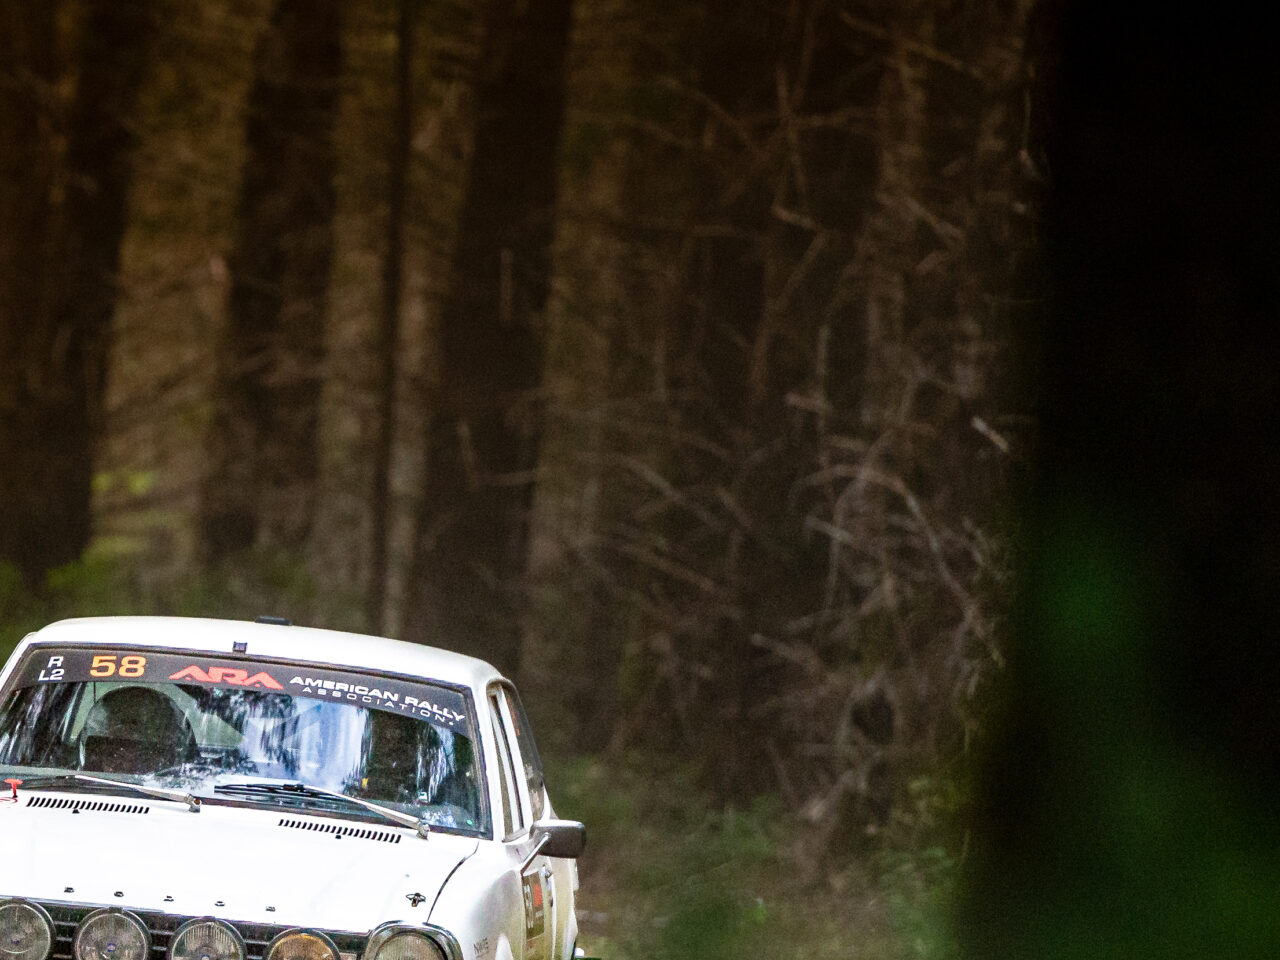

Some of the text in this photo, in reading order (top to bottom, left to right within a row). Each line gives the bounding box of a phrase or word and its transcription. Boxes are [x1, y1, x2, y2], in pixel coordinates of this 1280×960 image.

[47, 656, 64, 668] R
[89, 655, 148, 678] 58
[37, 668, 65, 682] L2
[168, 664, 285, 691] ARA
[289, 676, 466, 722] AMERICAN RALLY
[302, 686, 447, 723] ASSOCIATION
